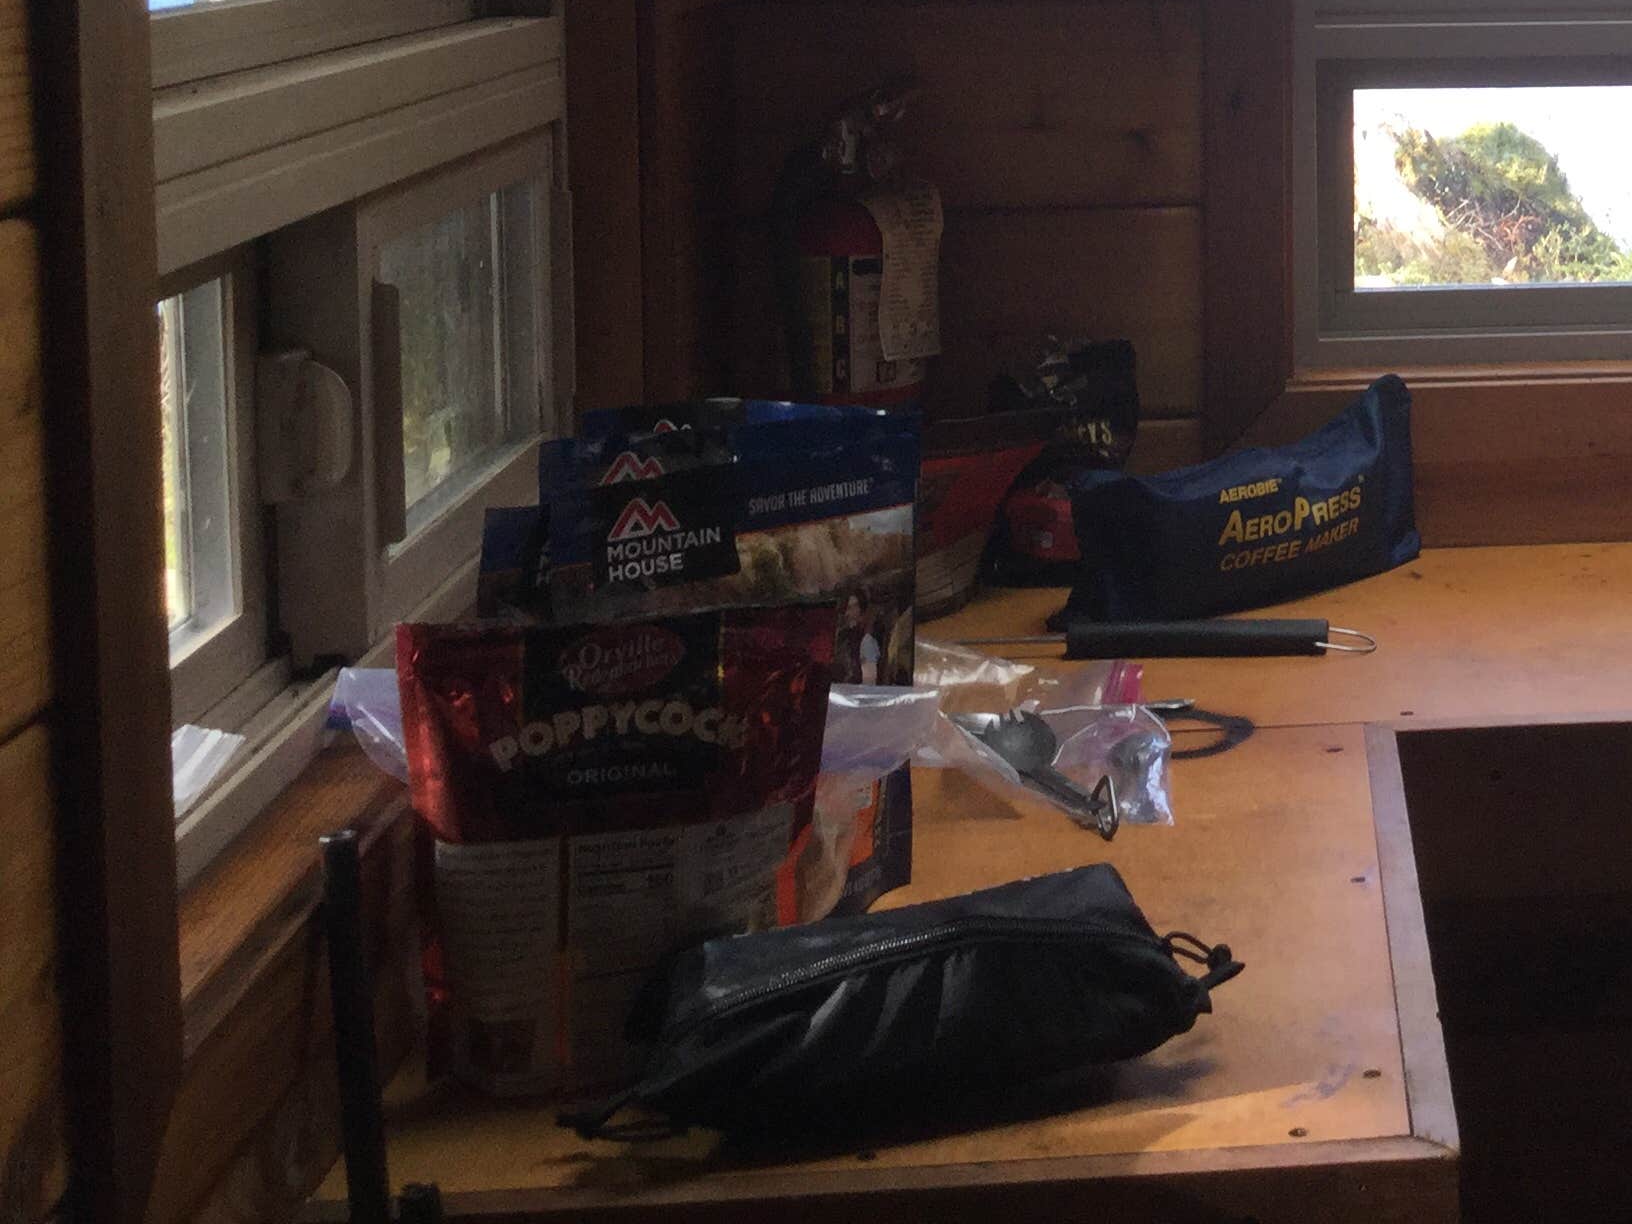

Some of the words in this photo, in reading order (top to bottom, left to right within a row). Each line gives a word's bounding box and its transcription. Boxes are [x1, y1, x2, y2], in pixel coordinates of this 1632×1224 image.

[750, 493, 785, 514] SAVOR
[787, 489, 807, 508] THE
[809, 481, 868, 503] ADVENTURE
[1219, 480, 1278, 505] AEROBIE
[607, 526, 721, 562] MOUNTAIN
[1219, 541, 1300, 572] COFFEE
[1307, 516, 1359, 555] MAKER
[608, 553, 684, 582] HOUSE
[489, 700, 750, 773] POPPYCOCK
[566, 761, 671, 786] ORIGINAL
